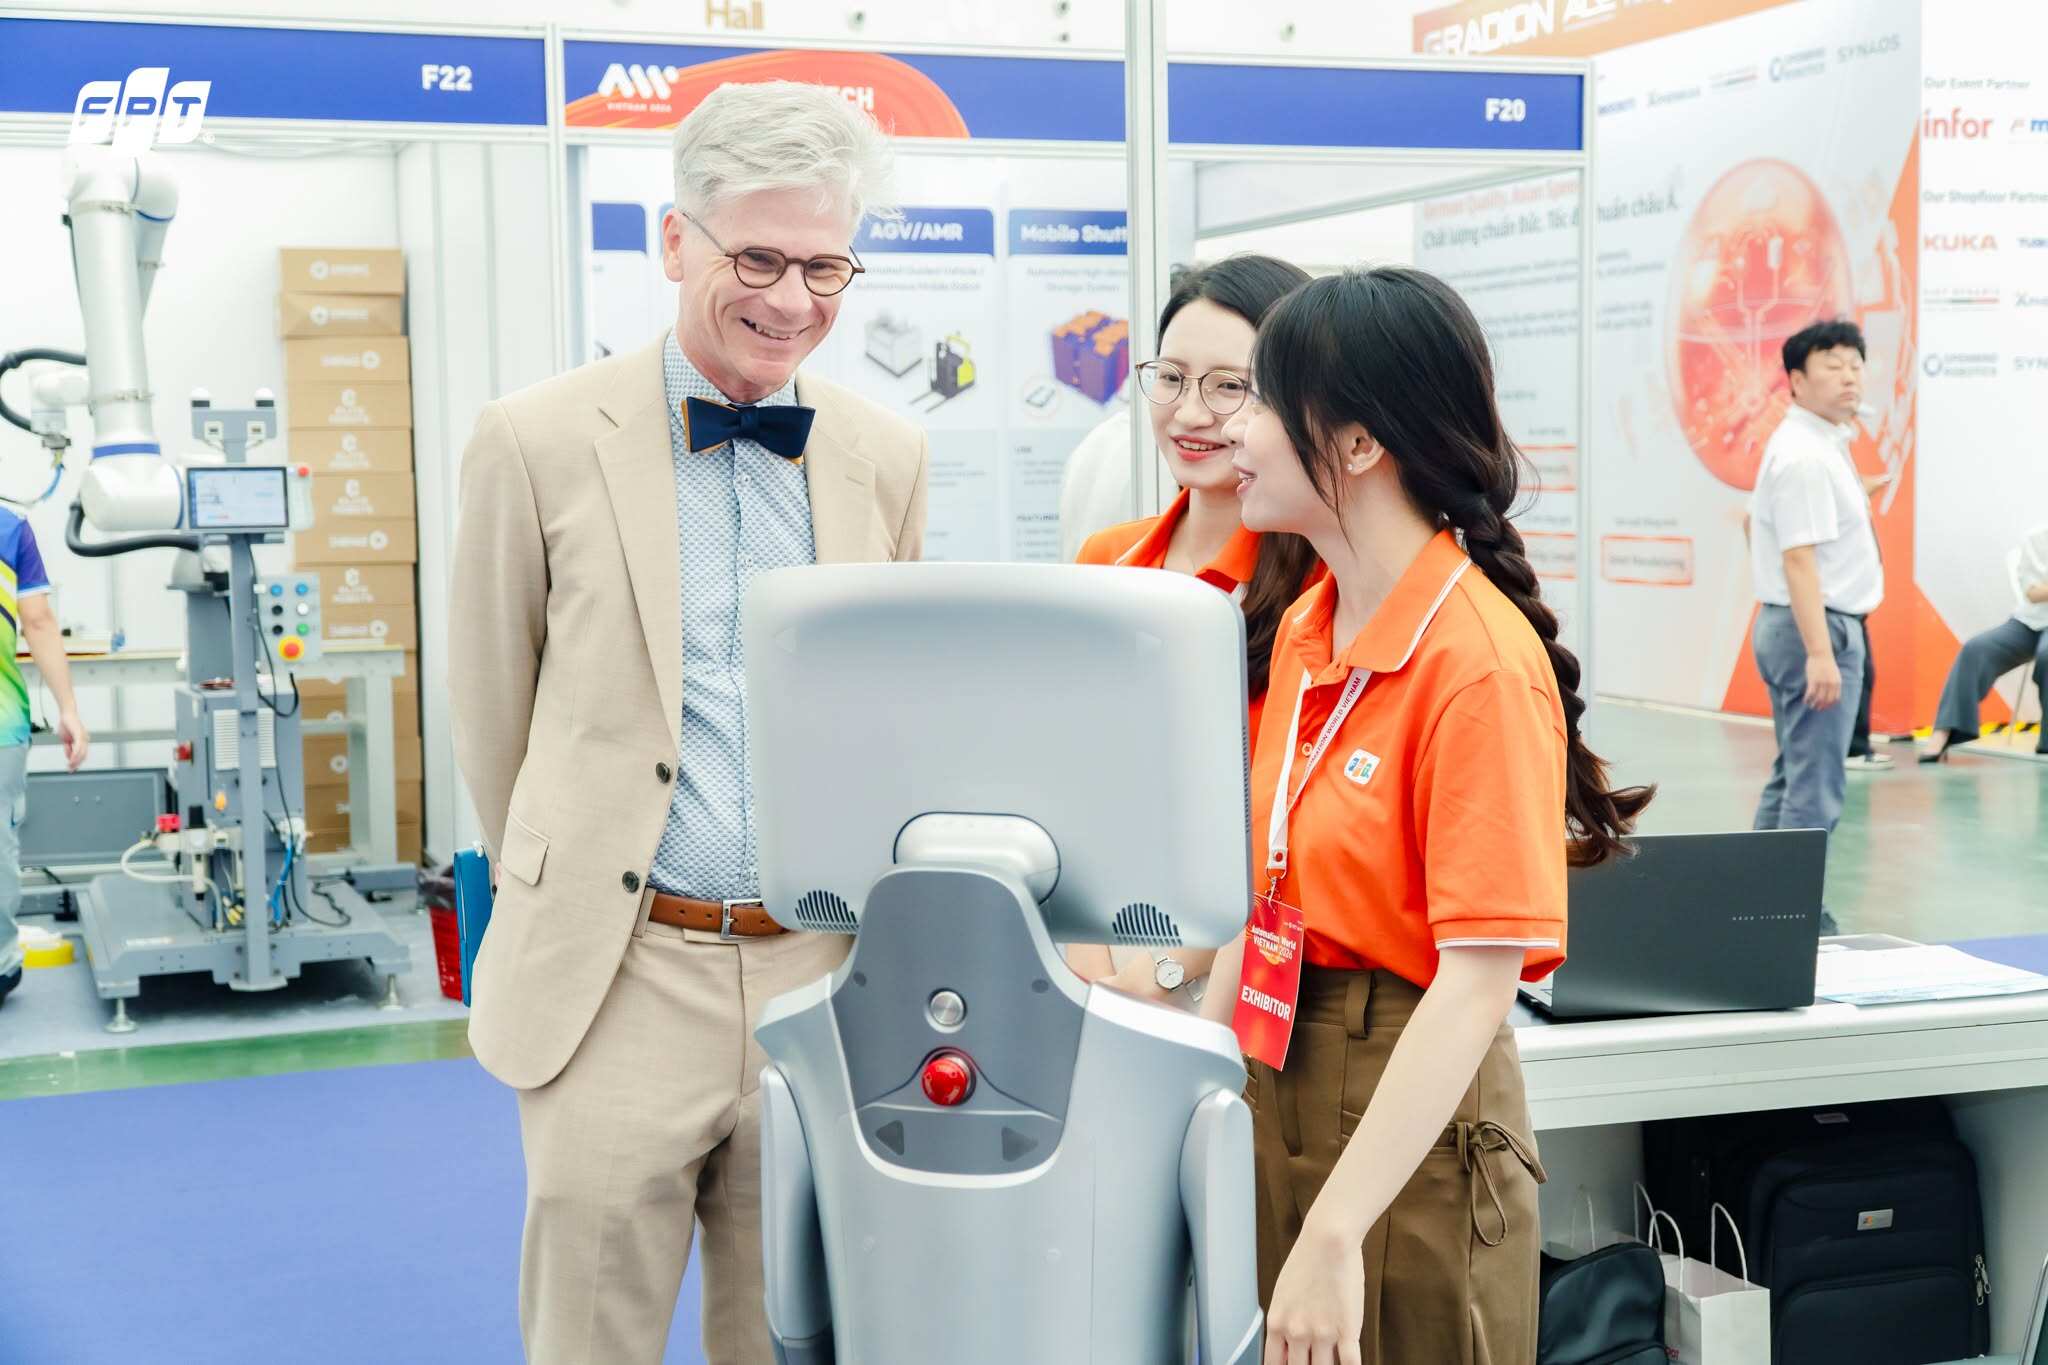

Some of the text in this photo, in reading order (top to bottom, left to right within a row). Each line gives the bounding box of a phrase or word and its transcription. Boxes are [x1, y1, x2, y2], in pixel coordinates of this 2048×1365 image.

[421, 64, 473, 92] F22
[1485, 98, 1527, 122] F20
[1923, 106, 1993, 138] infor
[869, 221, 964, 241] AGV/AMR
[1021, 223, 1080, 242] Mobile
[1924, 235, 1998, 251] KUKA
[1342, 676, 1362, 709] VIETNAM
[1251, 924, 1280, 944] Automation
[1281, 935, 1297, 951] World
[1253, 934, 1278, 952] VIETNAM
[1241, 985, 1291, 1022] EXHIBITOR
